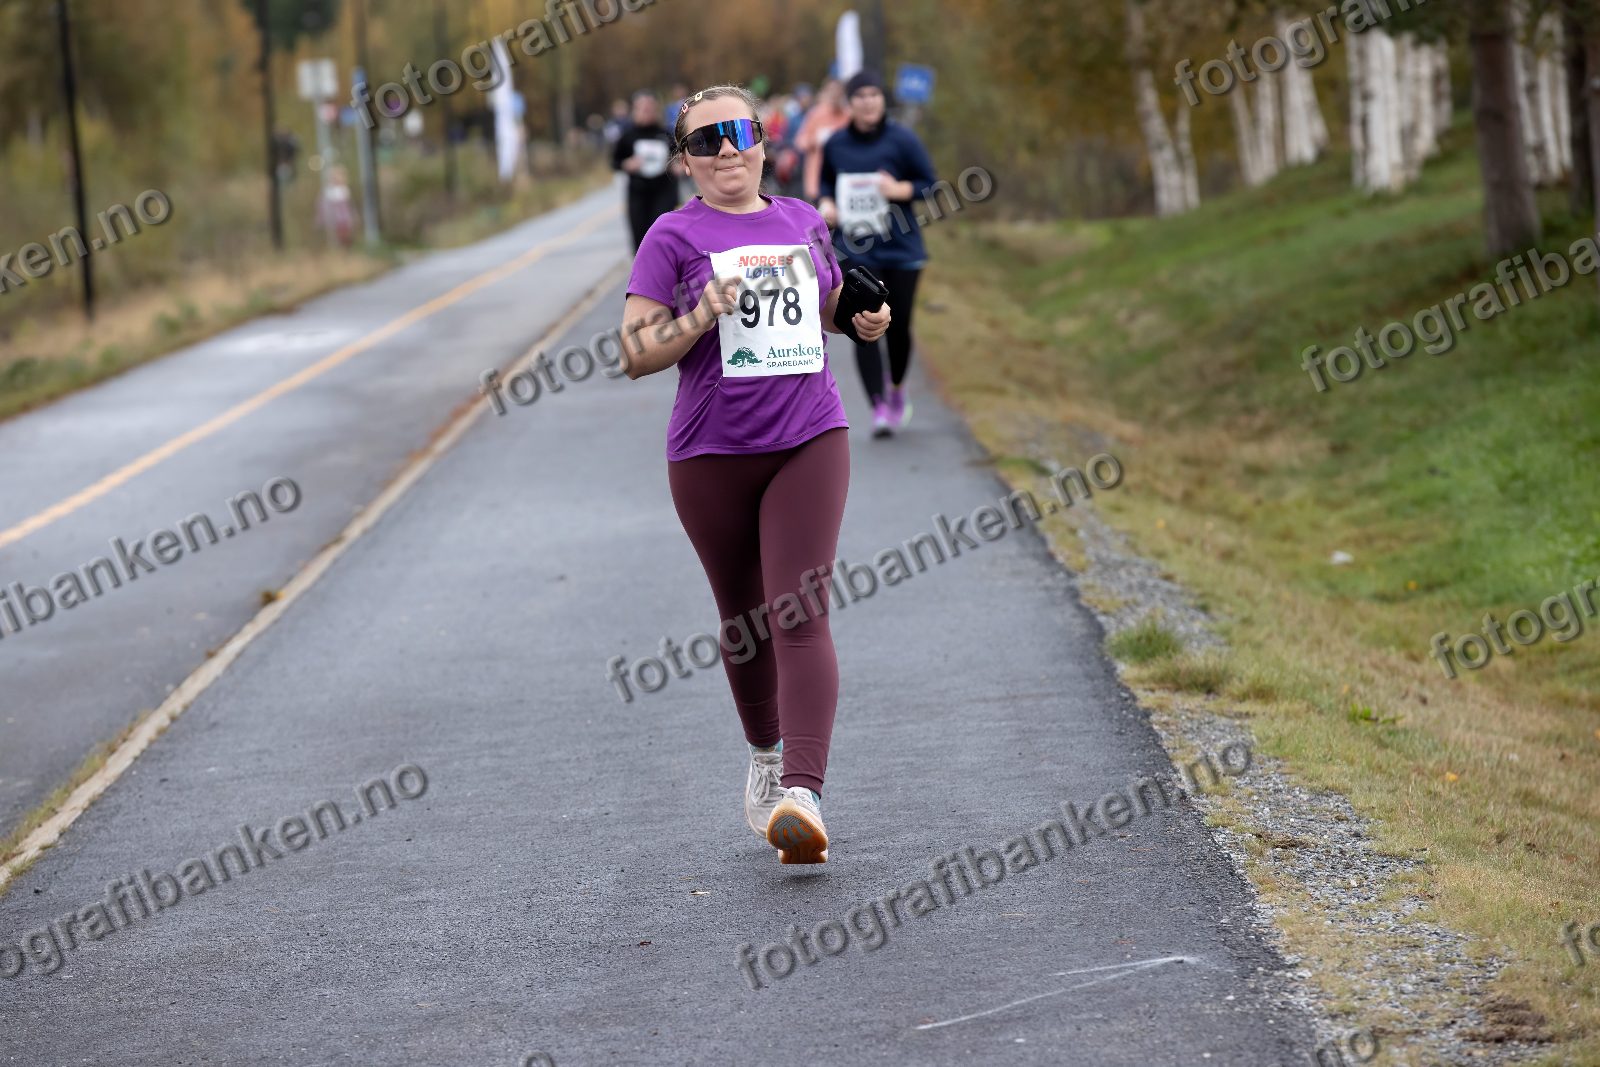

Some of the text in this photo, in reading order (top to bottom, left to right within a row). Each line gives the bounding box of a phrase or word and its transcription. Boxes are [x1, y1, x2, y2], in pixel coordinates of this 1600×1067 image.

[738, 255, 794, 267] NORGES
[745, 266, 786, 279] LØPET
[739, 287, 802, 328] 978
[767, 344, 822, 359] Aurskog
